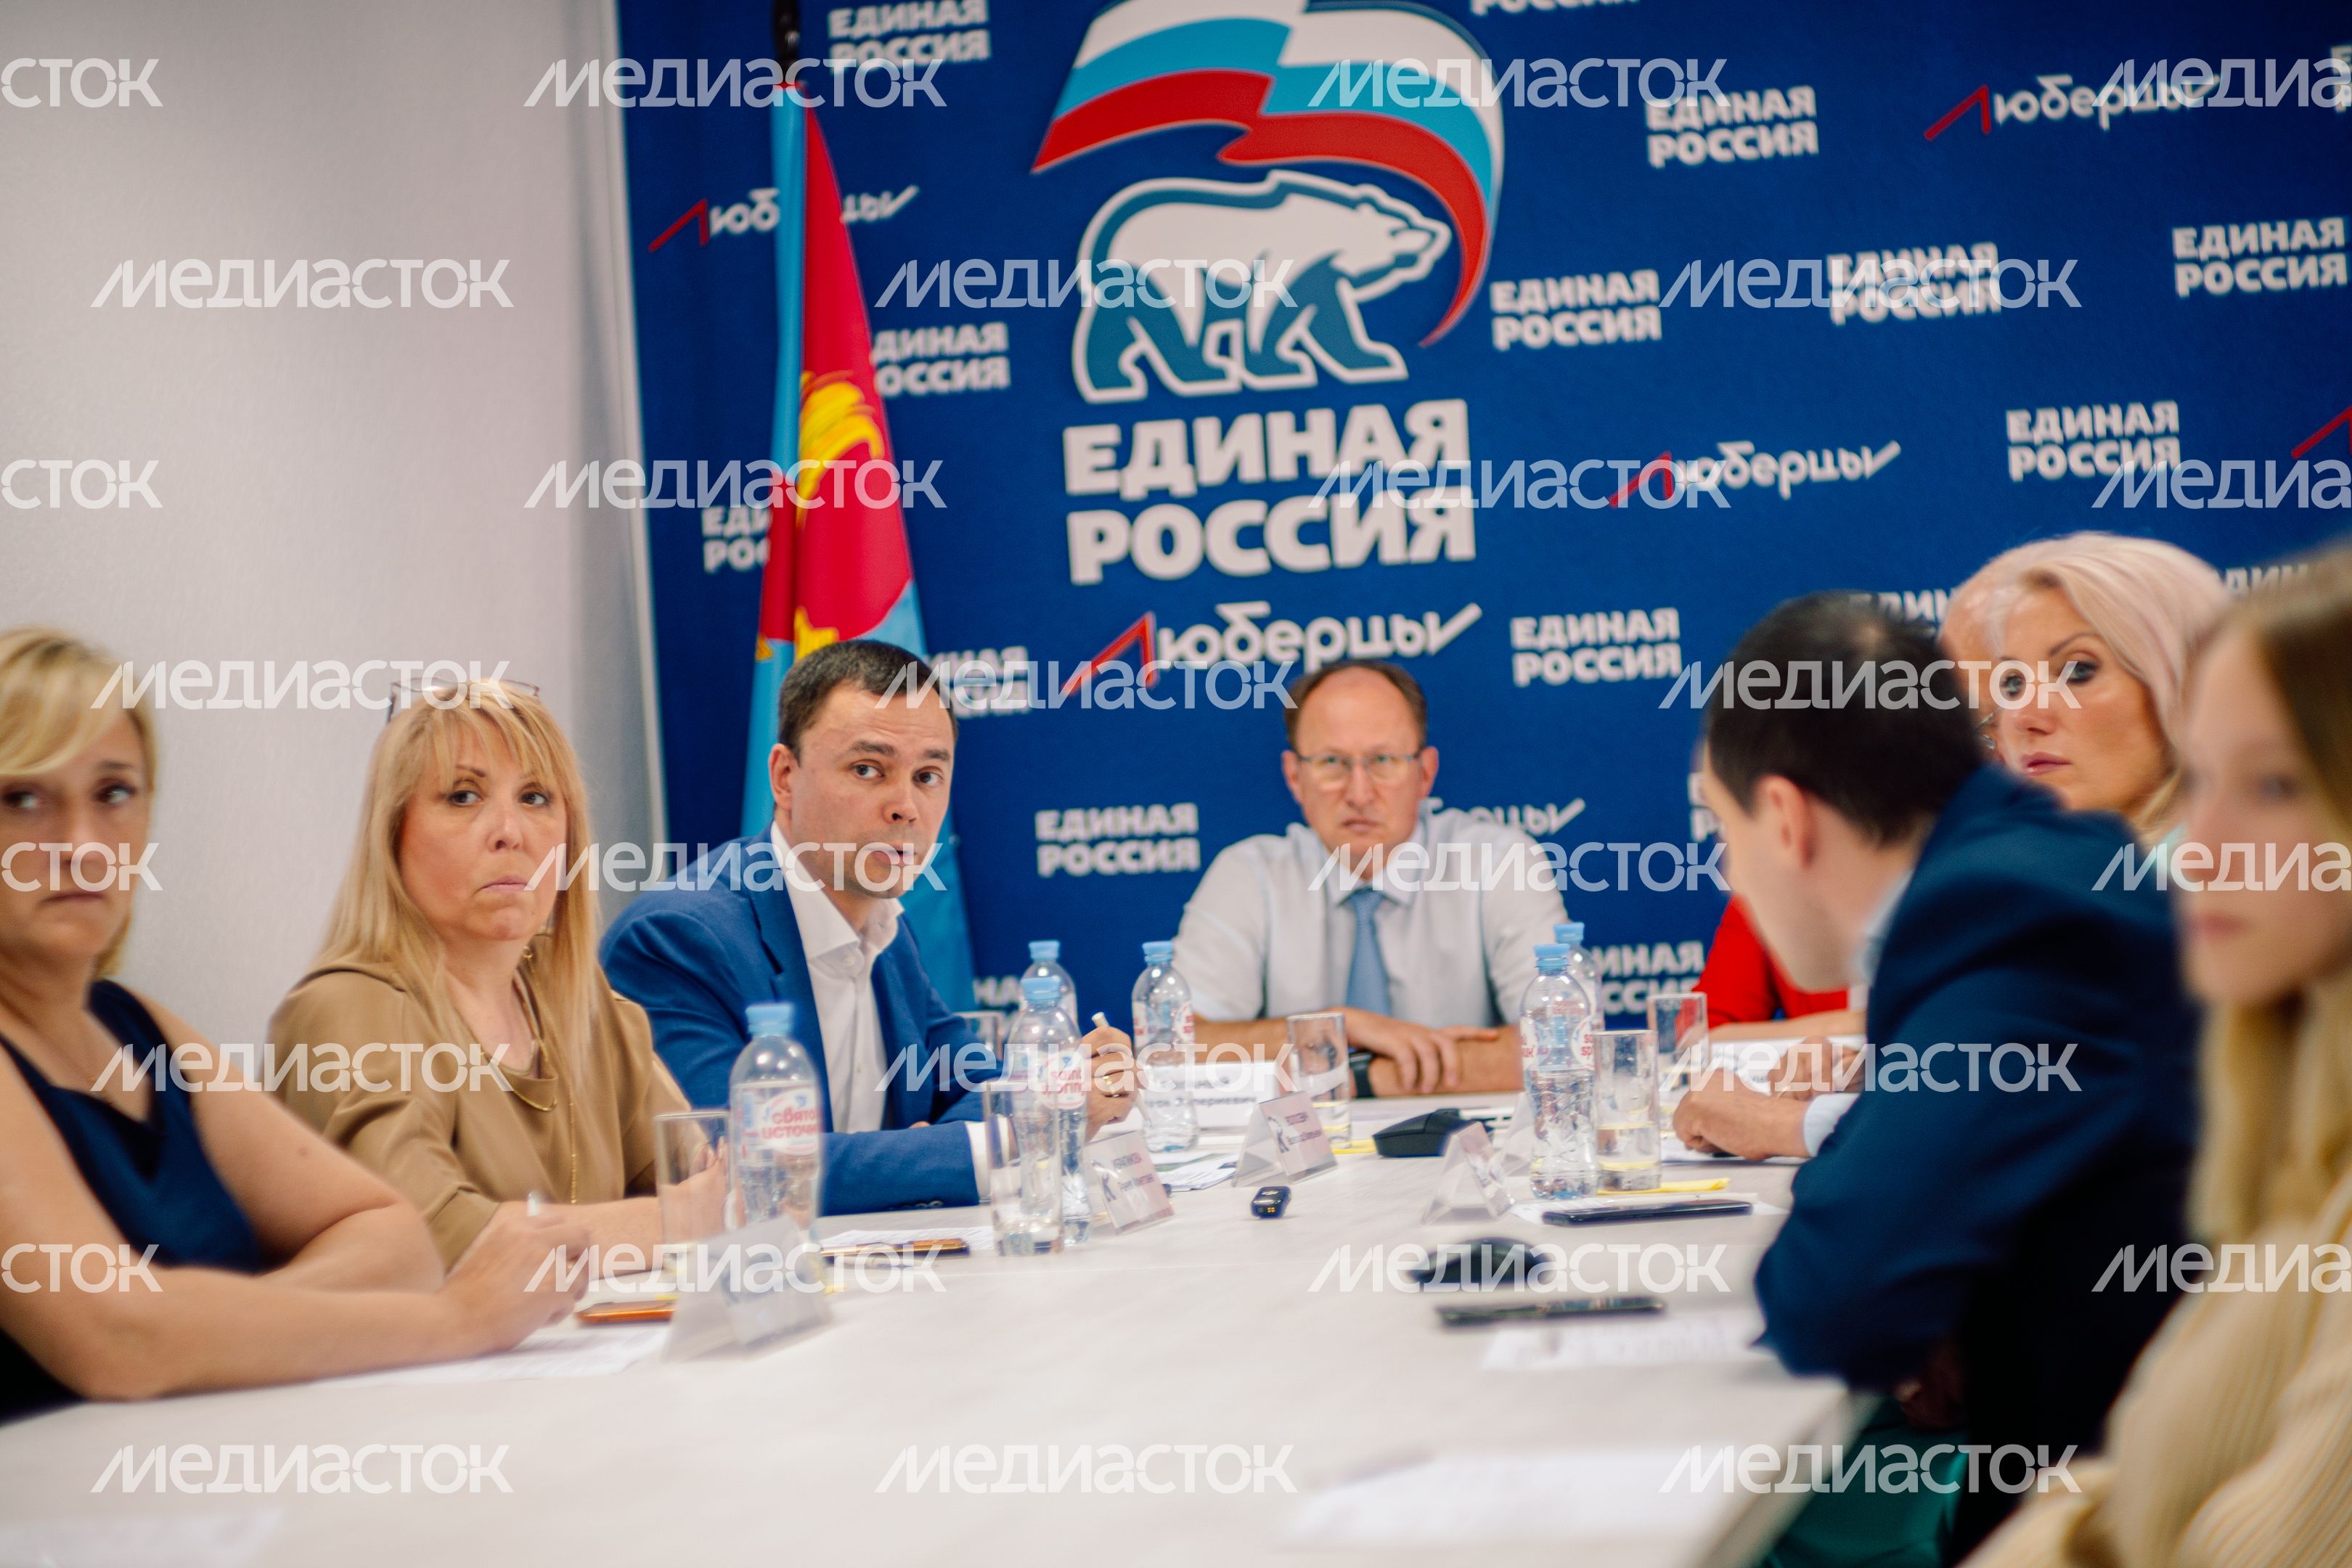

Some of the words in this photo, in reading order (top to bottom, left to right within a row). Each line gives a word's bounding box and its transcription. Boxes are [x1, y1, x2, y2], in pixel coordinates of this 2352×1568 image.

[828, 0, 989, 38] ЕДИНАЯ
[830, 29, 991, 75] РОССИЯ
[1646, 85, 1816, 131] ЕДИНАЯ
[1648, 121, 1818, 168] РОССИЯ
[2173, 218, 2345, 261] ЕДИНАЯ
[1827, 242, 1999, 285] ЕДИНАЯ
[2175, 253, 2348, 297] РОССИЯ
[1491, 271, 1659, 314] ЕДИНАЯ
[870, 322, 1008, 364] ДИНАЯ
[1493, 308, 1662, 351] РОССИЯ
[875, 356, 1010, 397] ОССИЯ
[2006, 400, 2179, 445] ЕДИНАЯ
[1063, 399, 1471, 501] ЕДИНАЯ
[2008, 436, 2181, 483] РОССИЯ
[1066, 485, 1477, 587] РОССИЯ
[1063, 602, 1482, 695] Люберцы
[1510, 608, 1680, 652] ЕДИНАЯ
[1513, 642, 1683, 688] РОССИЯ
[1034, 802, 1199, 843] ЕДИНАЯ
[1037, 837, 1201, 878] РОССИЯ
[1592, 941, 1704, 976] ИНАЯ
